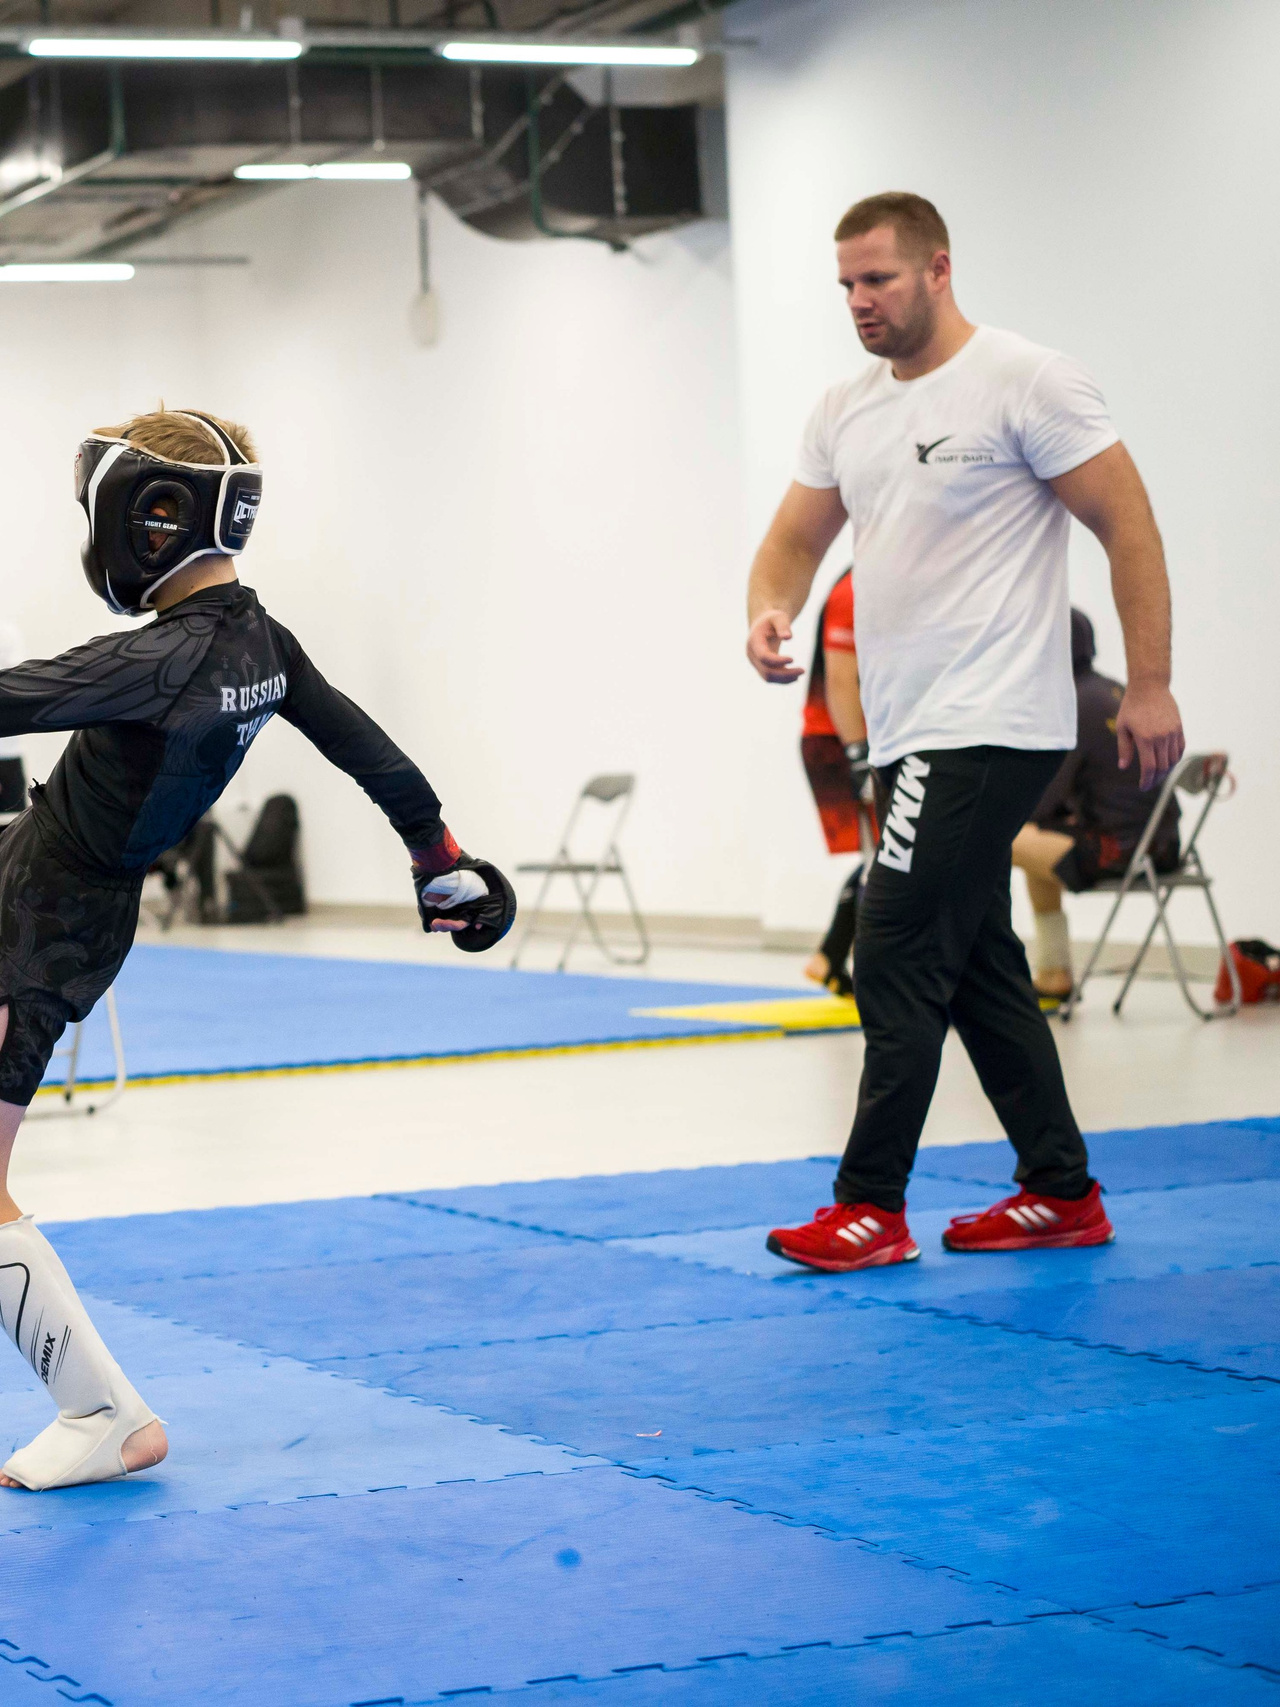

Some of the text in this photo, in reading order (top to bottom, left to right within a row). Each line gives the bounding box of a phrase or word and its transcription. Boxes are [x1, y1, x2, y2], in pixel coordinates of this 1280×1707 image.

[144, 520, 178, 531] FIGHT GEAR
[877, 755, 931, 874] MMA
[40, 1331, 56, 1386] DEMIX
